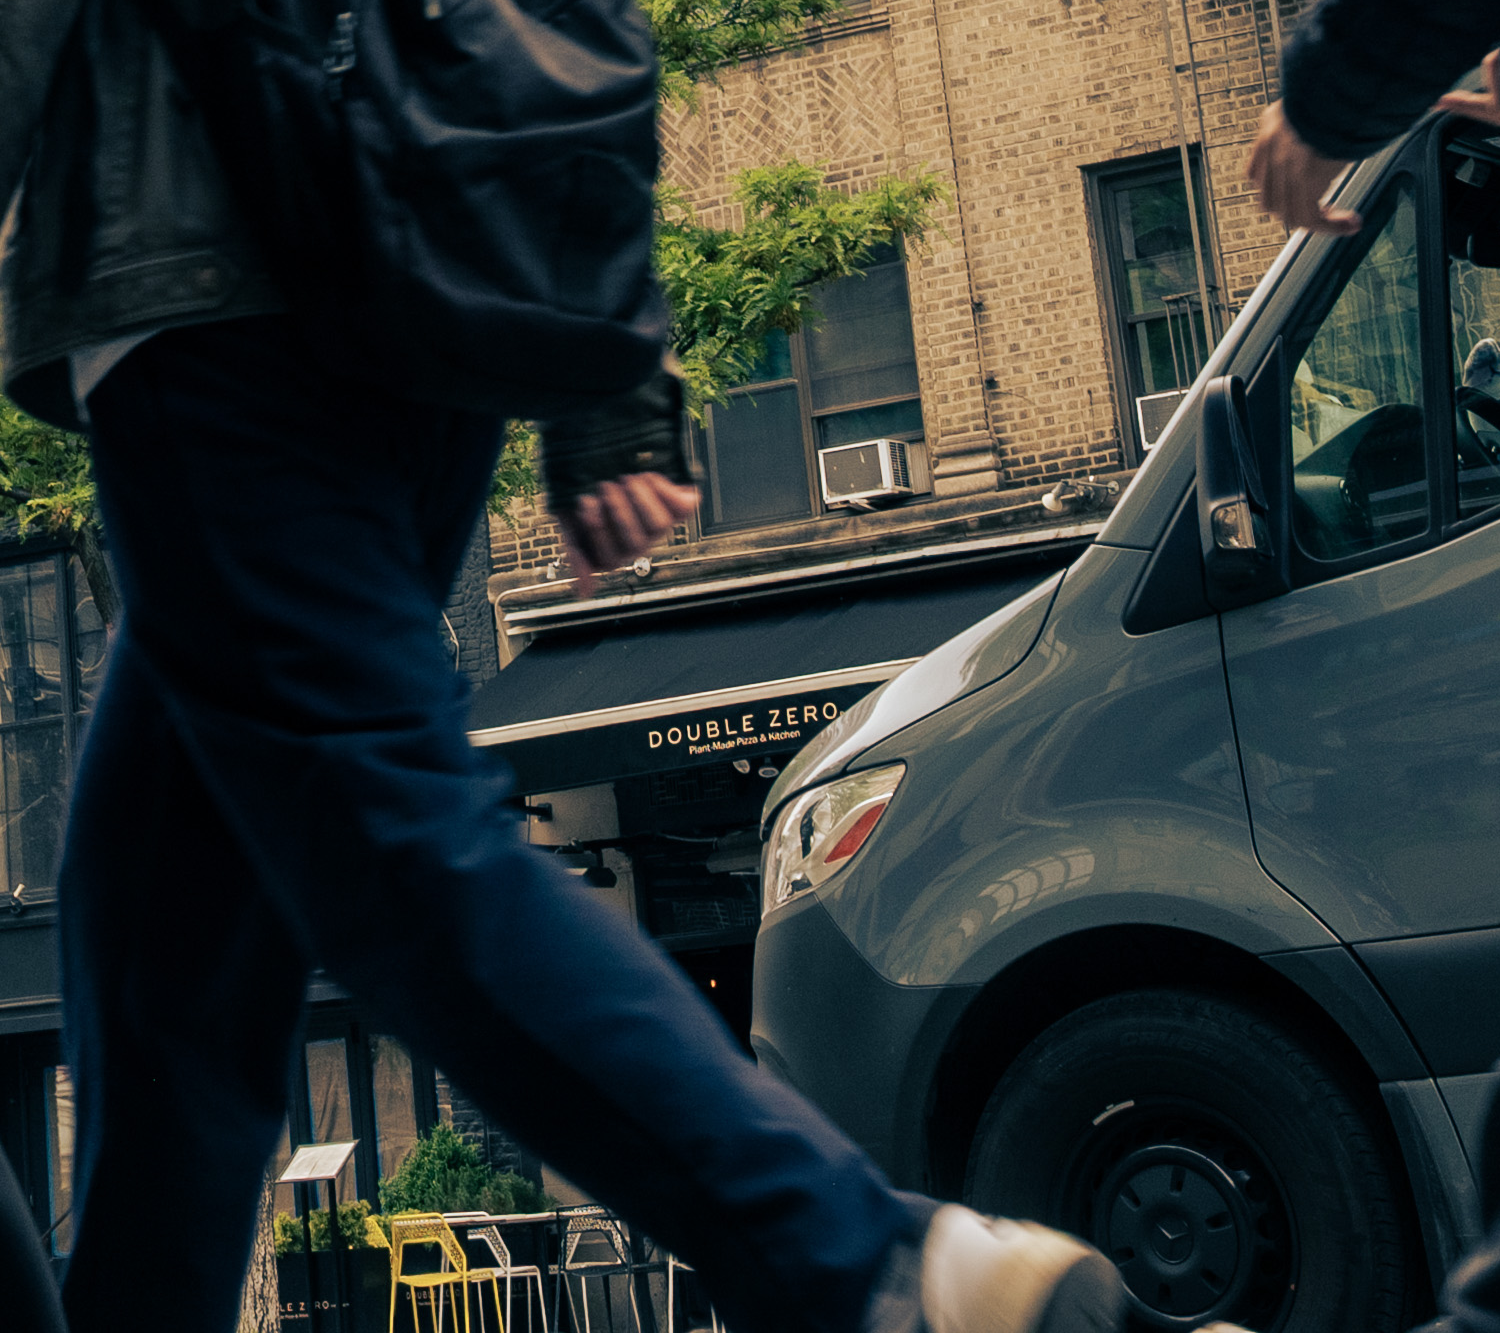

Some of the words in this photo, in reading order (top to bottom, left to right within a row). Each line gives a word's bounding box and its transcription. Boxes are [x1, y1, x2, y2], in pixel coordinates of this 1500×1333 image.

[648, 713, 755, 749] DOUBLE
[768, 701, 838, 728] ZERO
[688, 738, 736, 756] Plant-Made
[736, 734, 759, 747] Pizza
[759, 733, 767, 743] &
[768, 729, 801, 742] Kitchen
